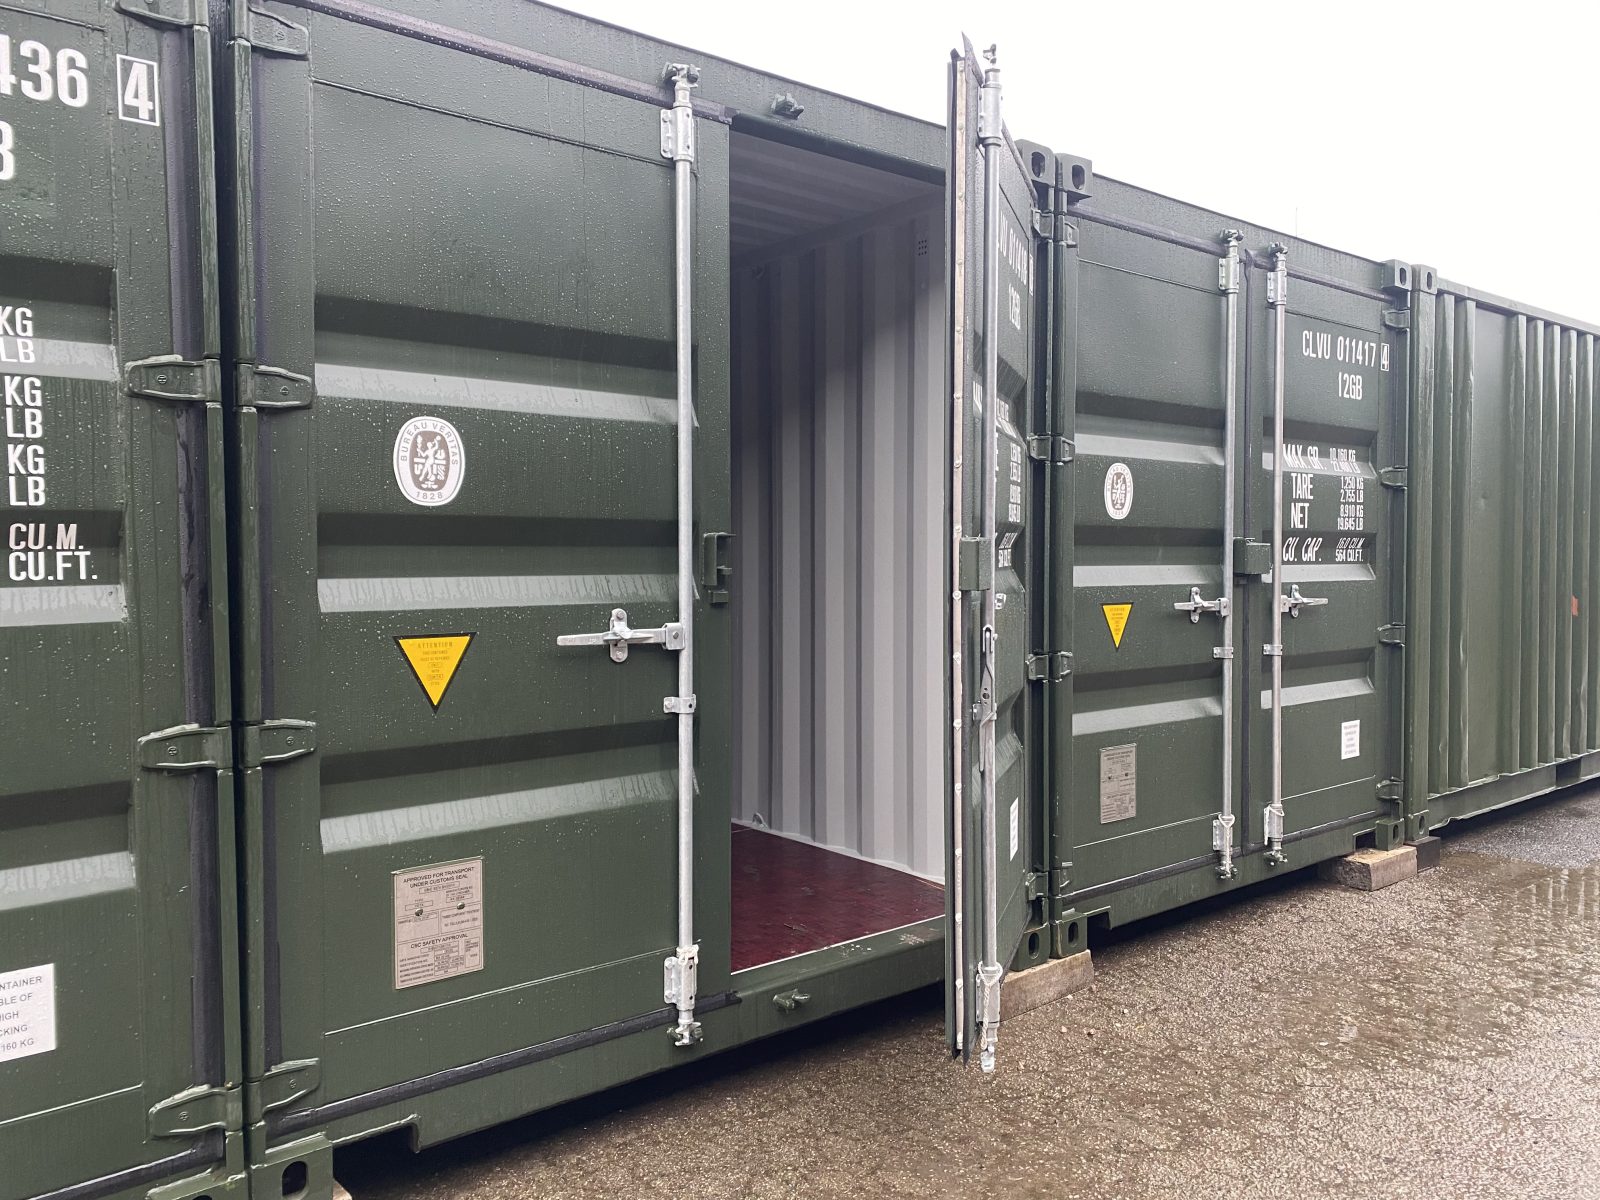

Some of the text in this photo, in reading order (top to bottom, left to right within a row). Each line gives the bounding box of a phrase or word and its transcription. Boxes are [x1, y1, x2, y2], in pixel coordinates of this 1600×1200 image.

[123, 62, 154, 120] 4
[0, 305, 34, 337] KG
[0, 337, 36, 363] LB
[1302, 330, 1331, 360] CLVU
[1336, 335, 1376, 367] 011417
[4, 375, 42, 407] KG
[1338, 371, 1363, 400] 12GB
[5, 407, 43, 438] LB
[400, 422, 458, 464] BUREAU VERITAS
[1348, 449, 1356, 462] KG
[7, 443, 45, 475] KG
[8, 475, 46, 506] LB
[416, 491, 443, 500] 1828
[1290, 472, 1314, 500] TARE
[1356, 477, 1364, 490] KG
[1356, 490, 1364, 503] LB
[1290, 502, 1310, 529] NET
[1355, 517, 1364, 531] LB
[1356, 504, 1364, 518] KG
[8, 522, 85, 551] CU.M.
[1301, 537, 1323, 562] CAP.
[8, 551, 98, 581] CU.FT.
[403, 875, 431, 883] APPROVED
[444, 866, 475, 876] TRANSPORT
[409, 879, 429, 888] UNDER
[429, 876, 454, 884] CUSTOMS
[422, 938, 441, 946] SAFETY
[441, 933, 468, 943] APPROVAL
[19, 992, 33, 1002] OF
[20, 1037, 34, 1048] KG
